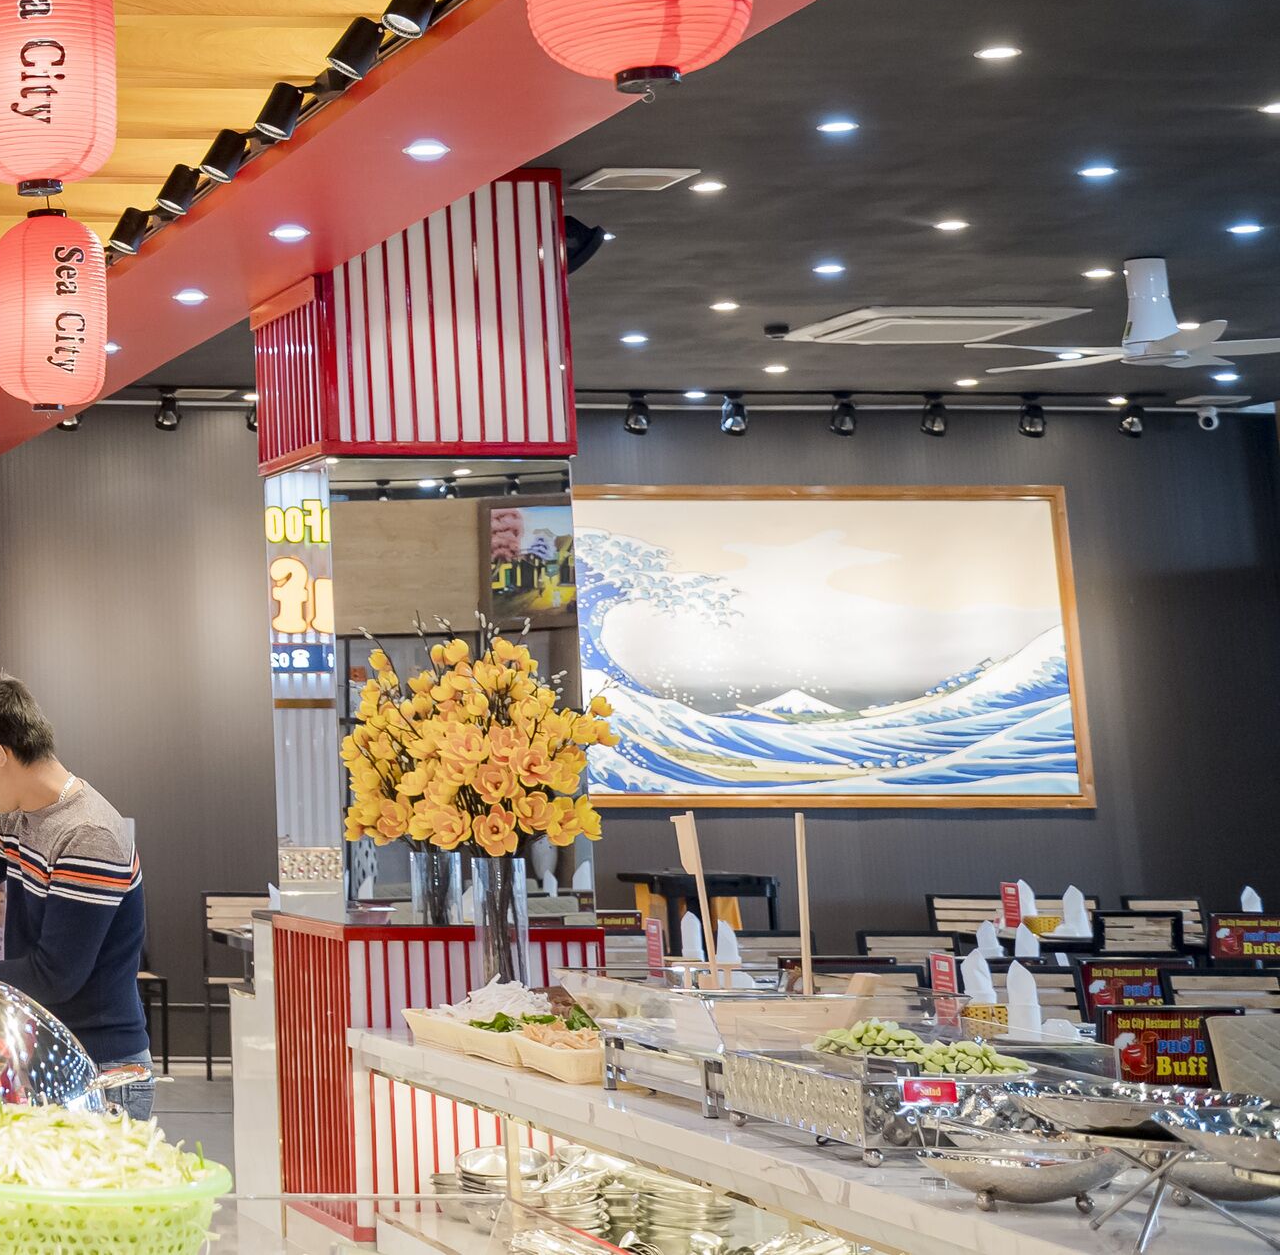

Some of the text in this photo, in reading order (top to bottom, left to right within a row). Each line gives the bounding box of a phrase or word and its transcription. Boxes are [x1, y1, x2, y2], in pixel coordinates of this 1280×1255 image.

[10, 40, 66, 125] City
[47, 246, 86, 373] Sea City
